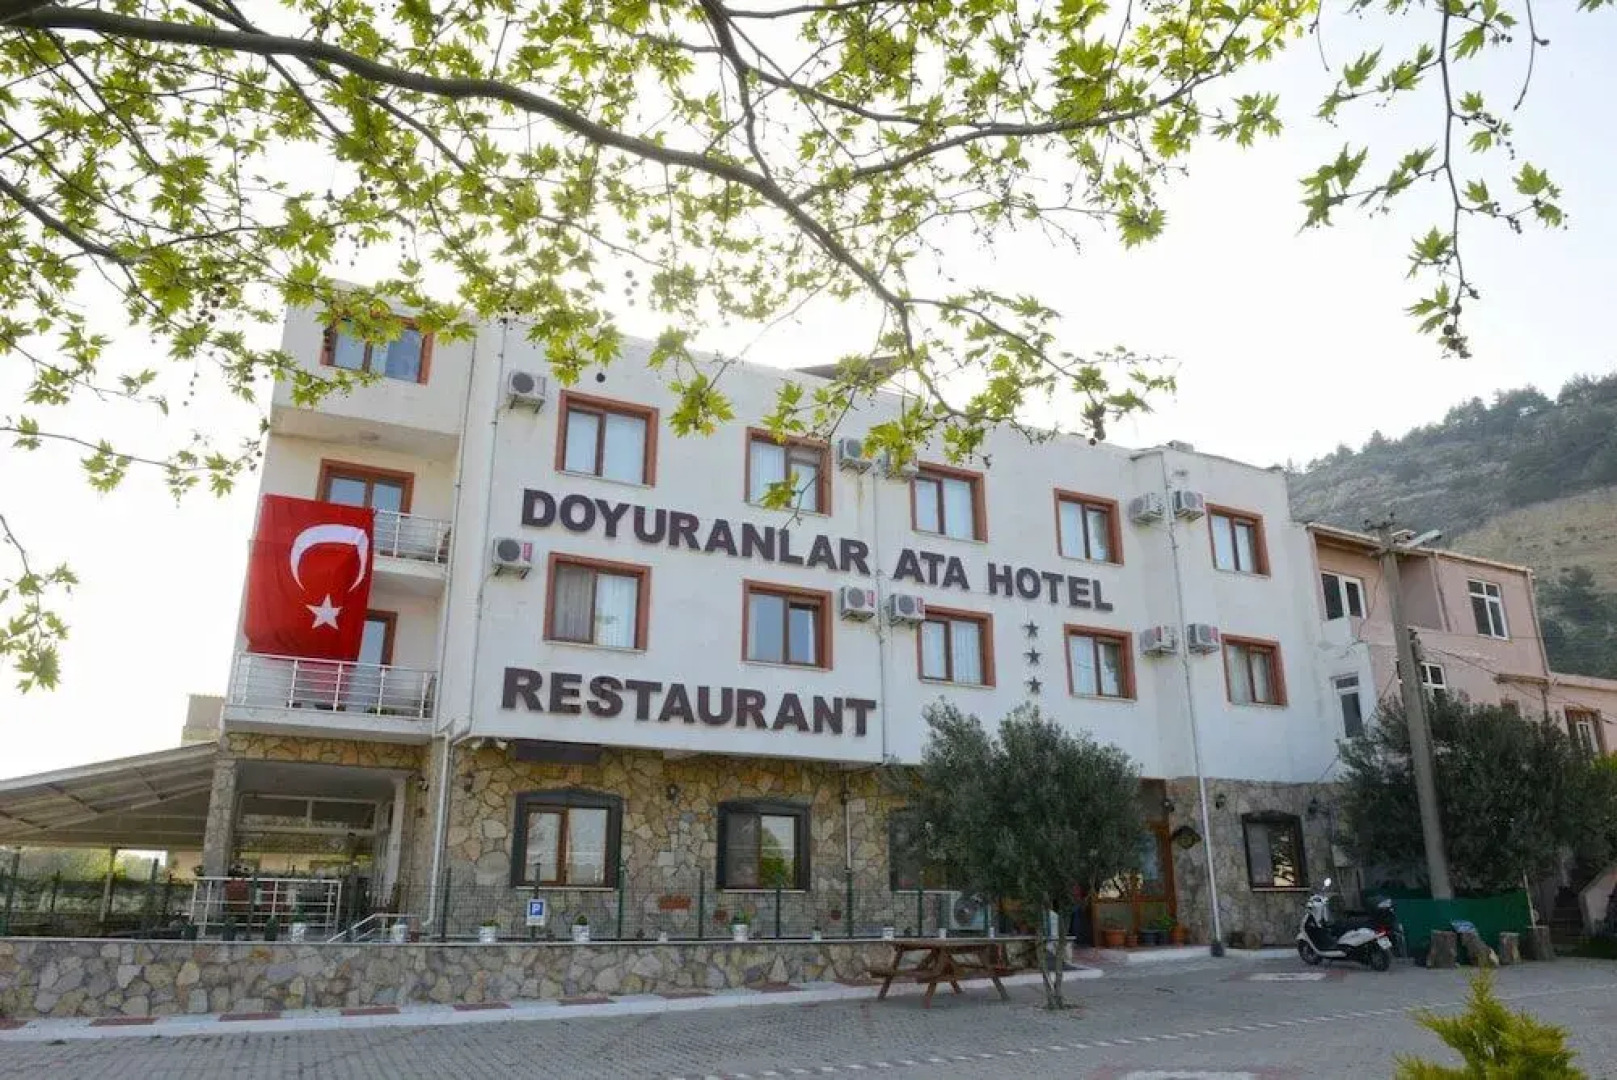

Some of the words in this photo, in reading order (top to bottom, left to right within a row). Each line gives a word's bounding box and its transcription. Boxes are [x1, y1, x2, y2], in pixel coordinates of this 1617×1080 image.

[520, 487, 871, 577] DOYURANLAR
[892, 548, 971, 592] ATA
[987, 562, 1114, 612] HOTEL
[500, 666, 877, 738] RESTAURANT
[531, 903, 541, 915] P
